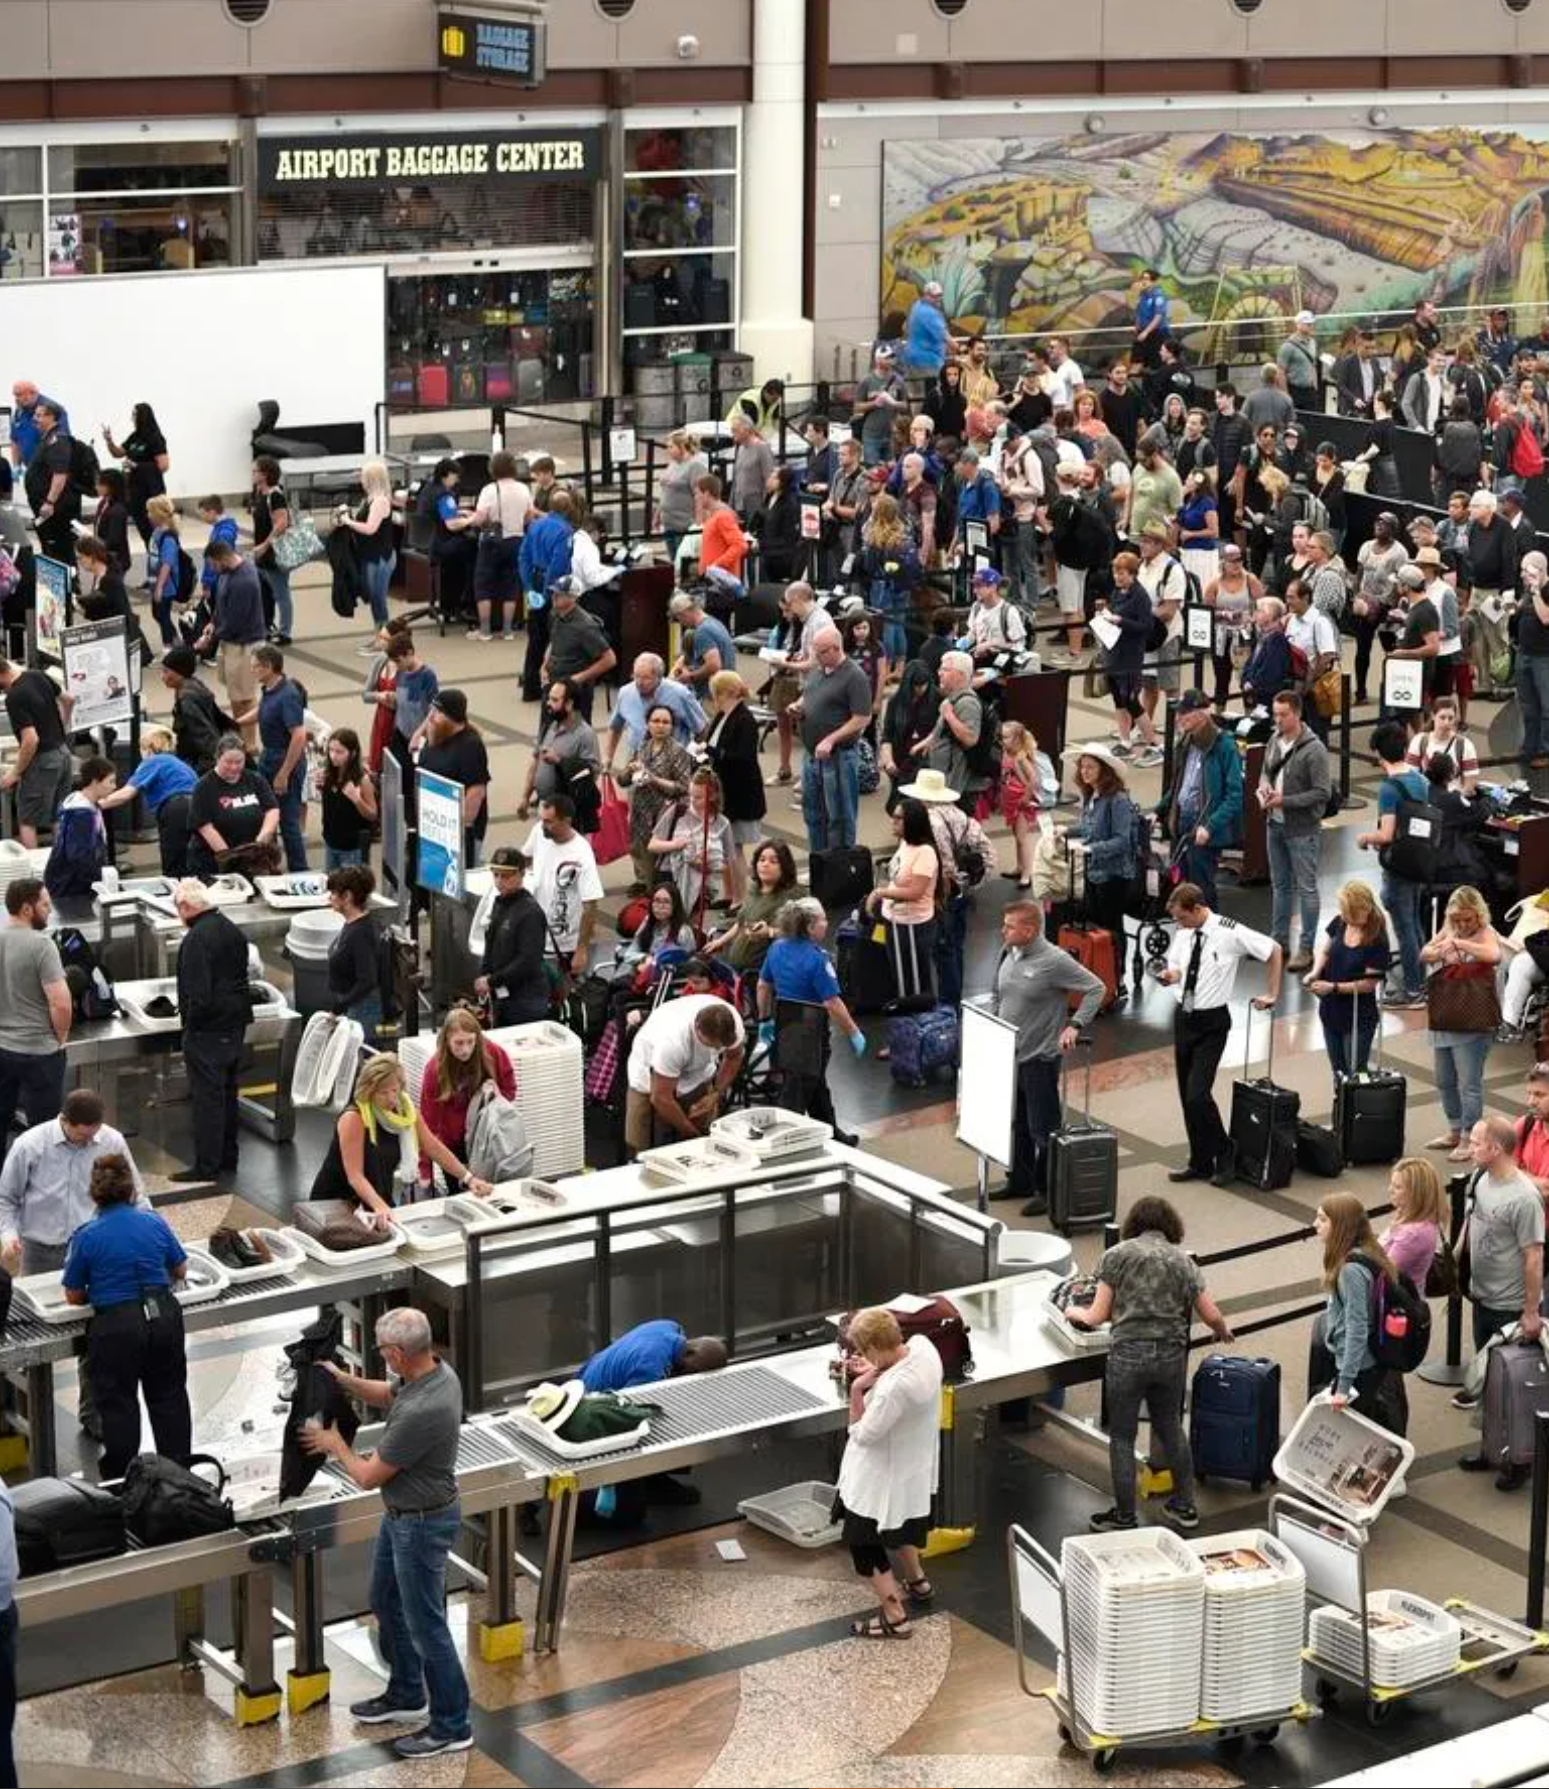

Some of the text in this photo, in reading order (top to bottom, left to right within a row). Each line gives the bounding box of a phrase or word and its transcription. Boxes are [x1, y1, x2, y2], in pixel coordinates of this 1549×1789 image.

[476, 23, 530, 50] BAGGAGE
[476, 45, 530, 73] STORAGE
[275, 140, 585, 180] AIRPORT BAGGAGE CENTER
[422, 808, 447, 828] HOLD
